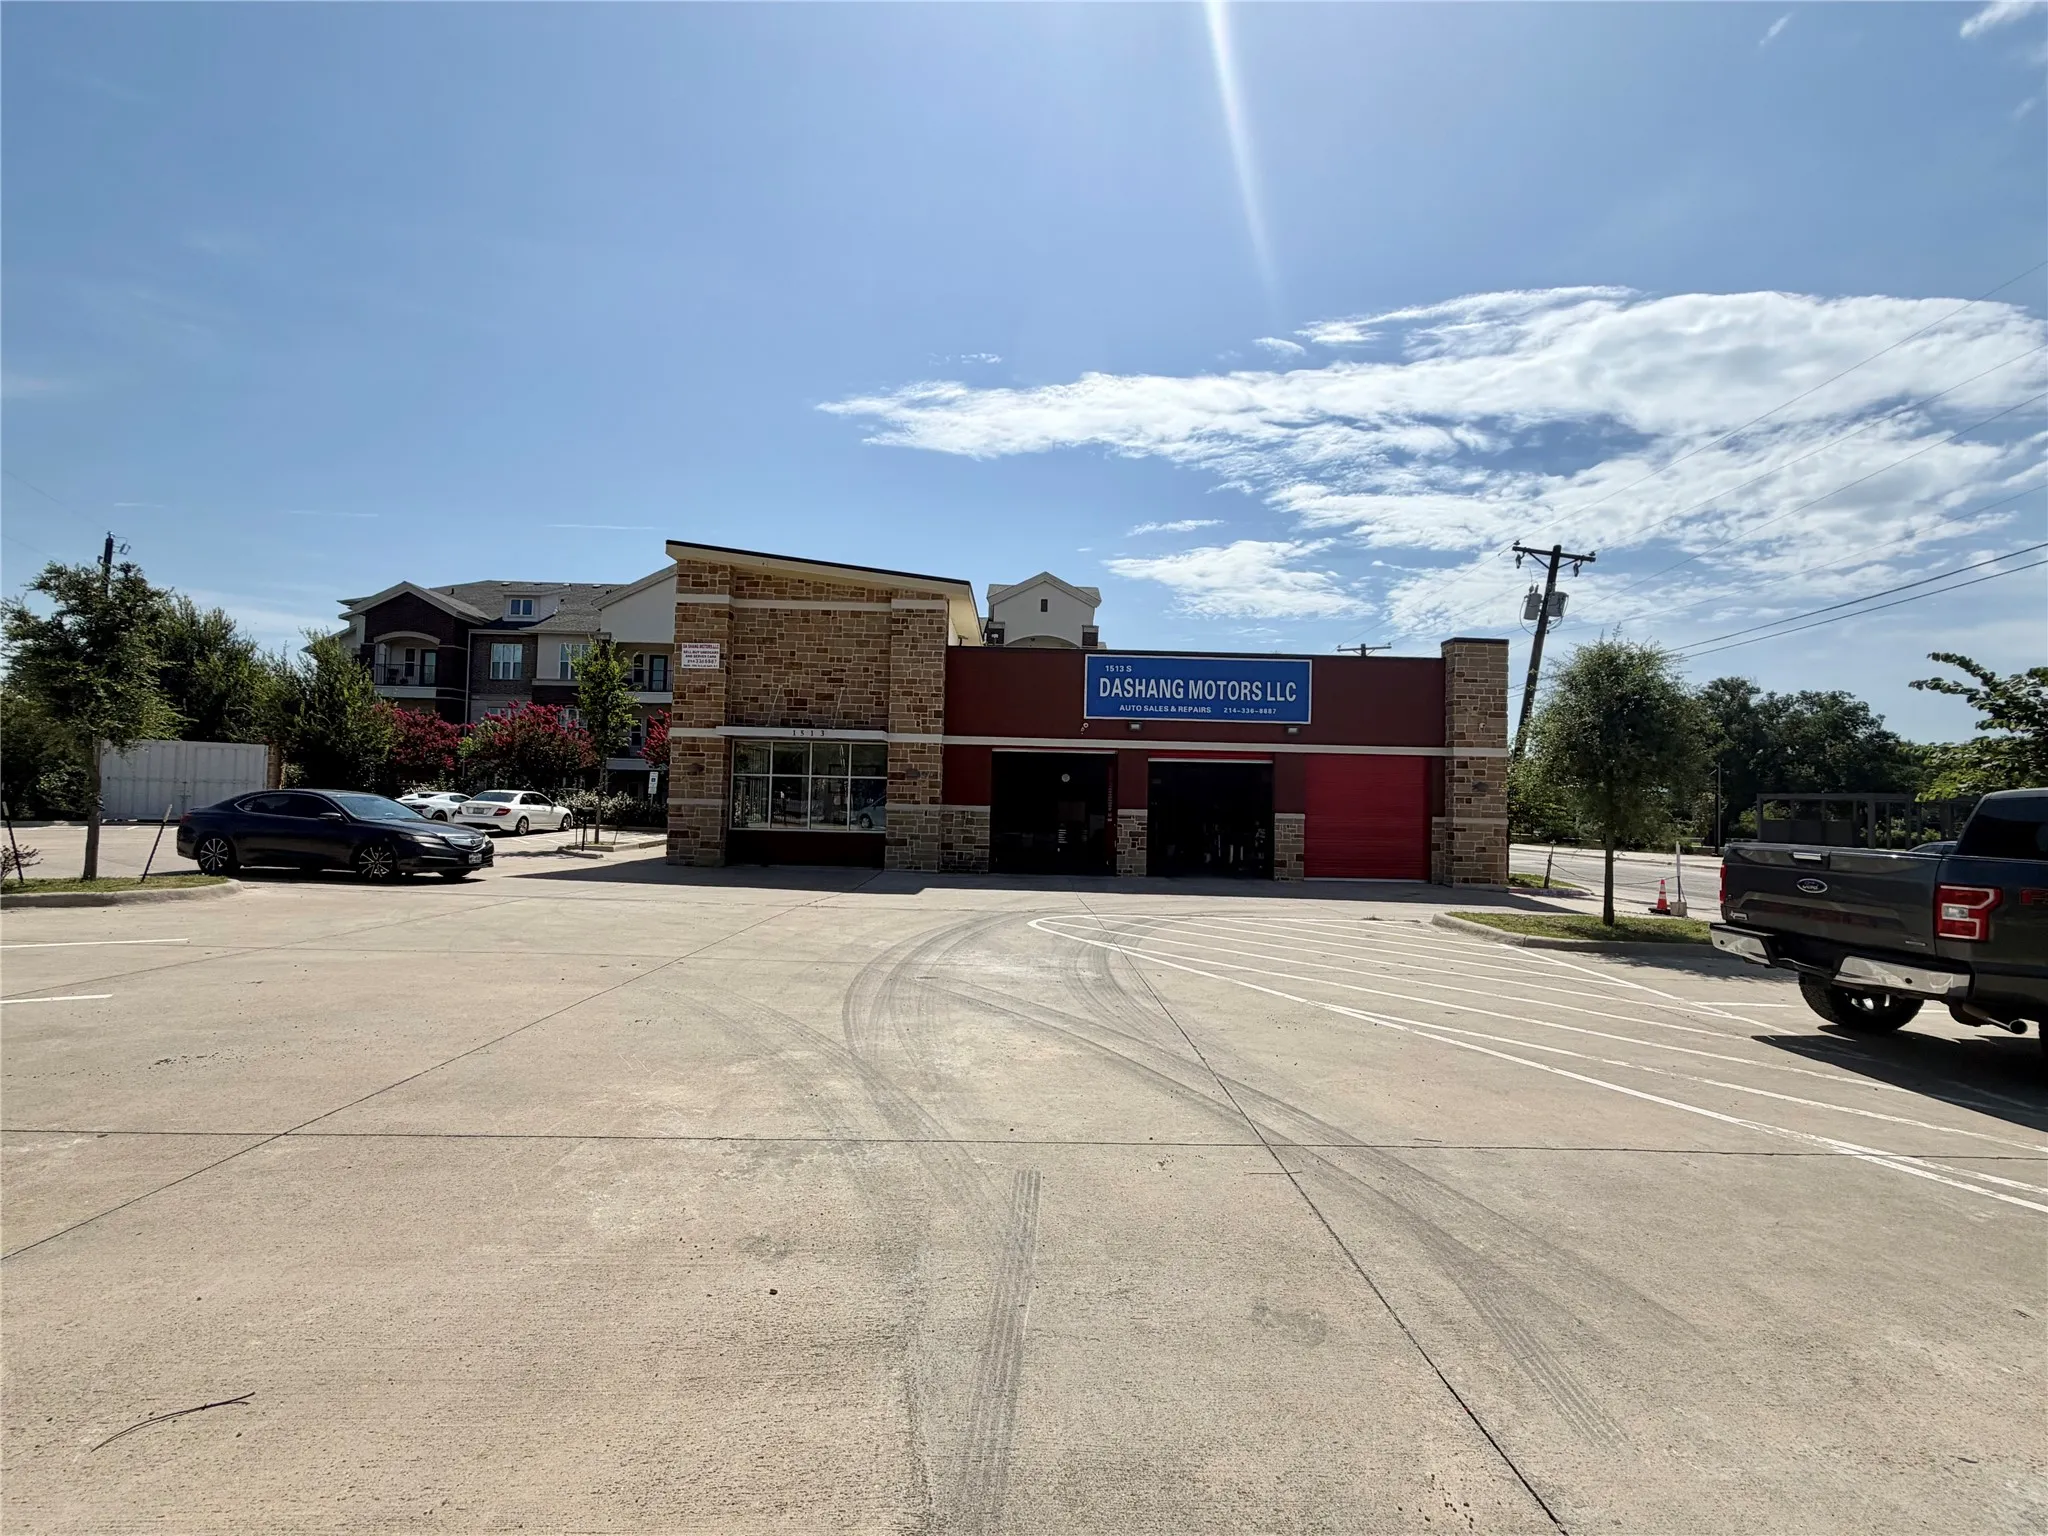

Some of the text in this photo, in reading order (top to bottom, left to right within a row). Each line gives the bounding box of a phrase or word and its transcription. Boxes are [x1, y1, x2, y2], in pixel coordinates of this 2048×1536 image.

[1100, 678, 1297, 702] DASHANG MOTORS LLC
